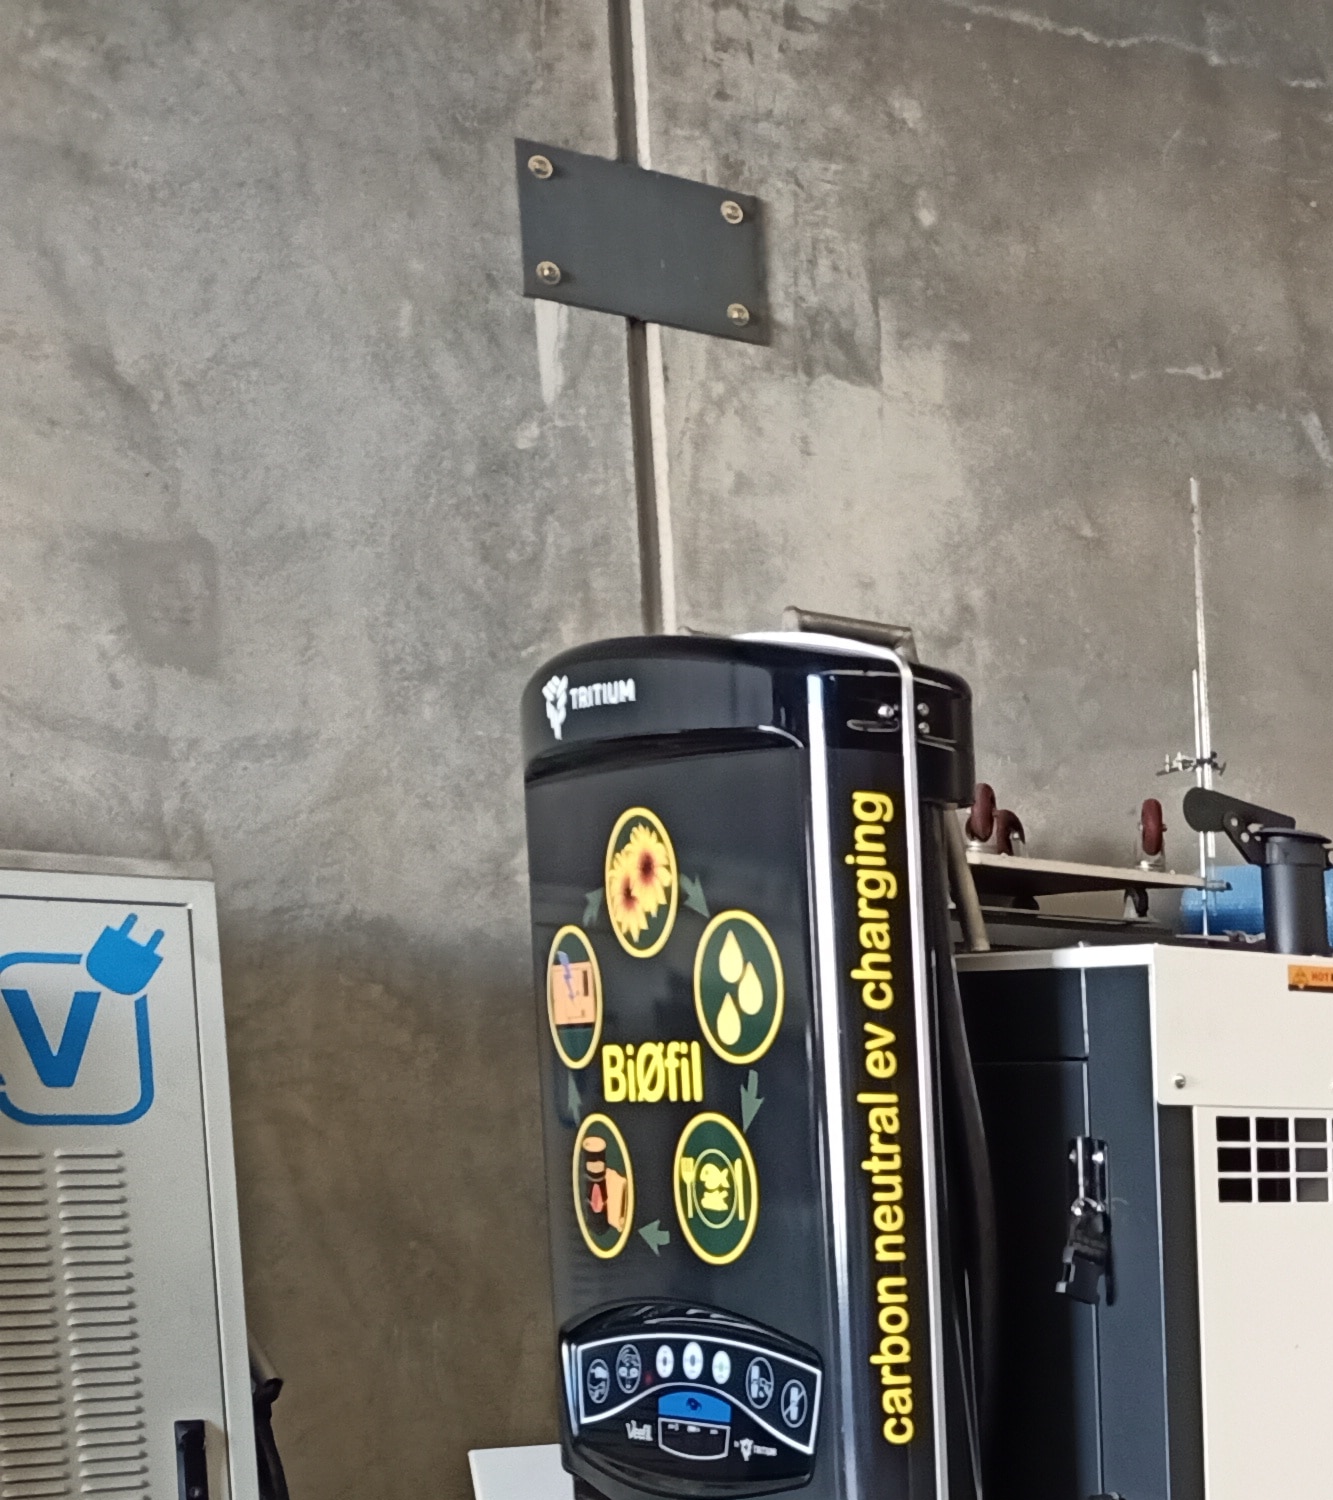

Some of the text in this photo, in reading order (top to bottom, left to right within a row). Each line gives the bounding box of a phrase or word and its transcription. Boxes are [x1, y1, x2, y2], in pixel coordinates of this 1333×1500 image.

[569, 678, 636, 710] TRITIUM
[845, 790, 914, 1445] carbon neutral ev charging
